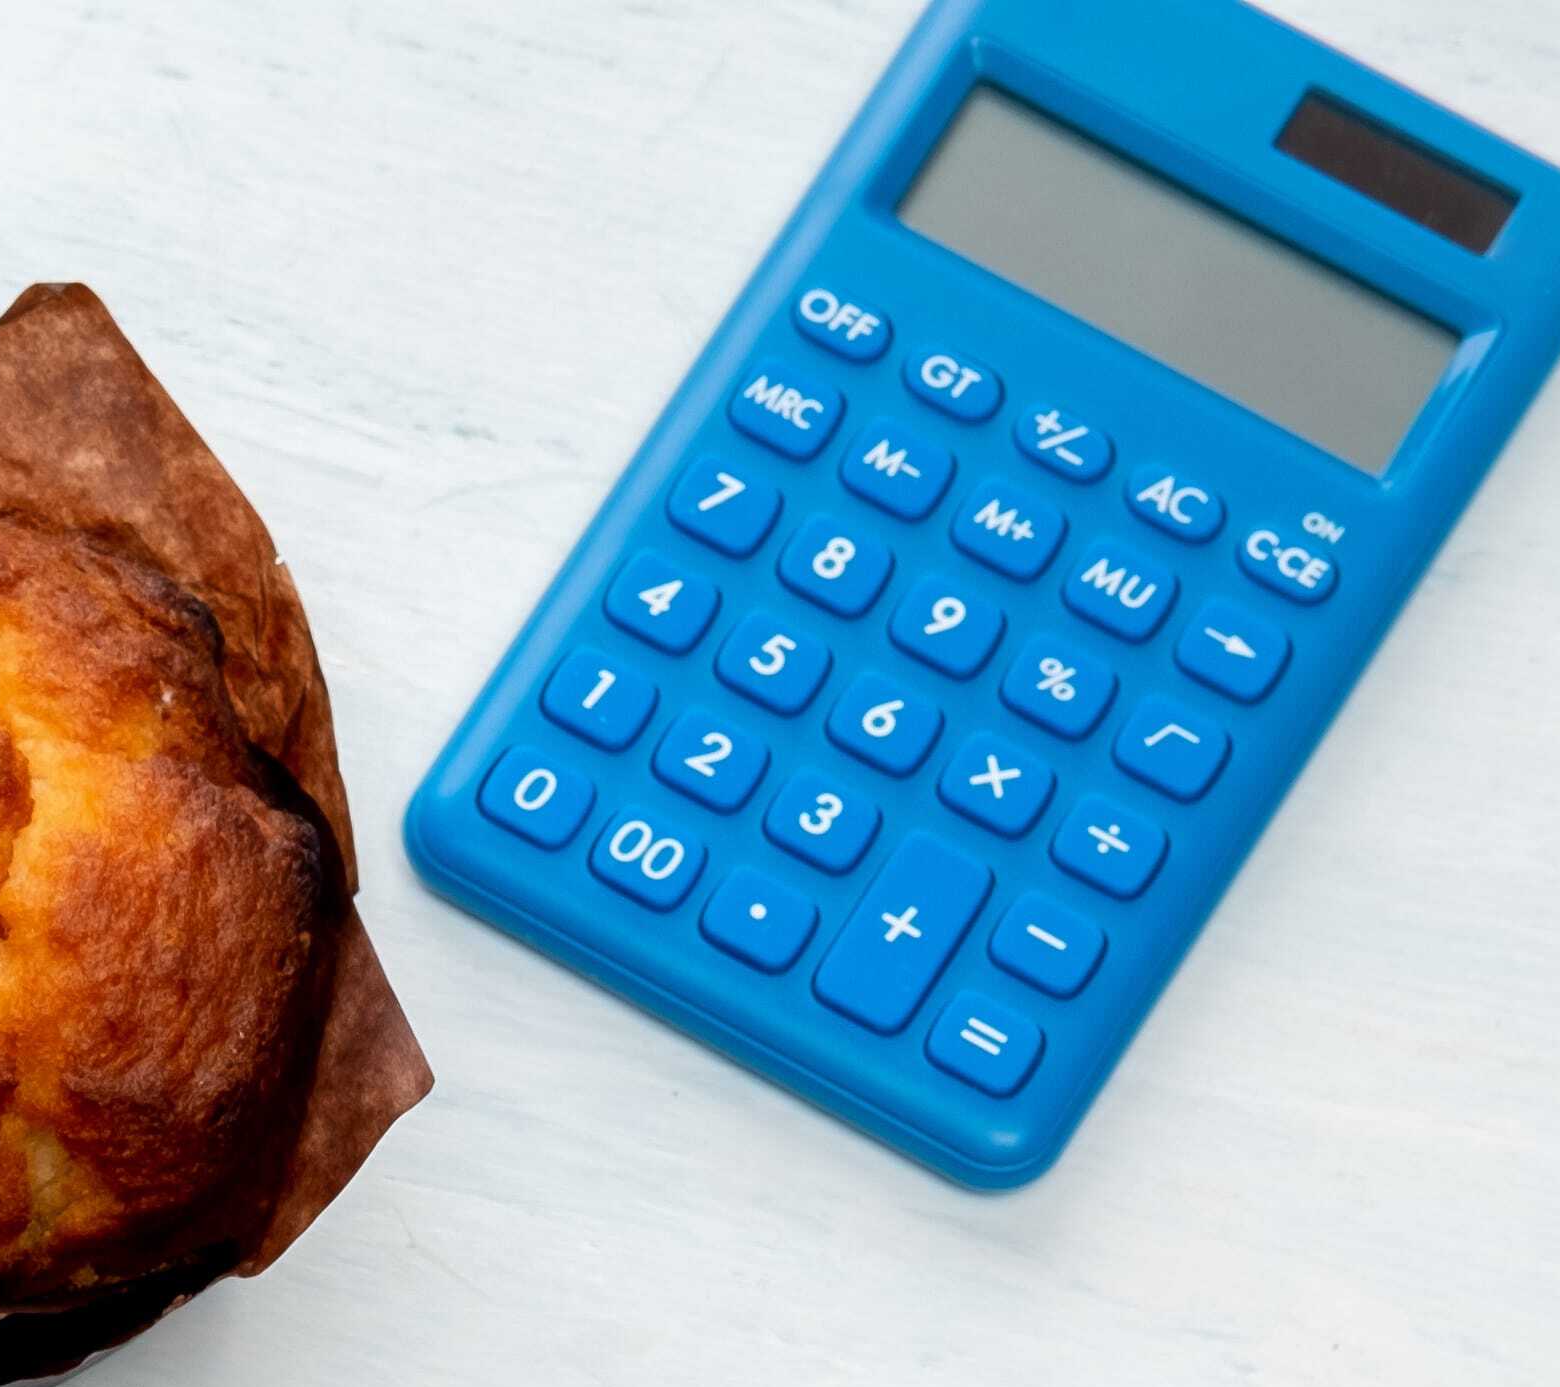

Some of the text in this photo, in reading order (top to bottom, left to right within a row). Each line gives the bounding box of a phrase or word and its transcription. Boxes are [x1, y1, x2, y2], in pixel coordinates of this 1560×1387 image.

[744, 376, 823, 430] MRC
[974, 499, 1035, 545] M+
[1081, 558, 1156, 609] MU
[799, 289, 880, 341] OFF
[920, 355, 981, 398] GT
[1136, 476, 1208, 524] AC
[698, 472, 746, 512] 7
[811, 536, 856, 580] 8
[924, 596, 967, 635] 9
[1037, 657, 1077, 705] %
[1302, 512, 1343, 542] ON
[638, 579, 683, 617] 4
[749, 634, 797, 676] 5
[861, 699, 905, 738] 6
[513, 768, 558, 811] 0
[608, 820, 685, 881] 00
[960, 1017, 1008, 1056] =
[581, 669, 616, 710] 1
[684, 731, 733, 777] 2
[798, 792, 844, 836] 3
[881, 906, 922, 943] +
